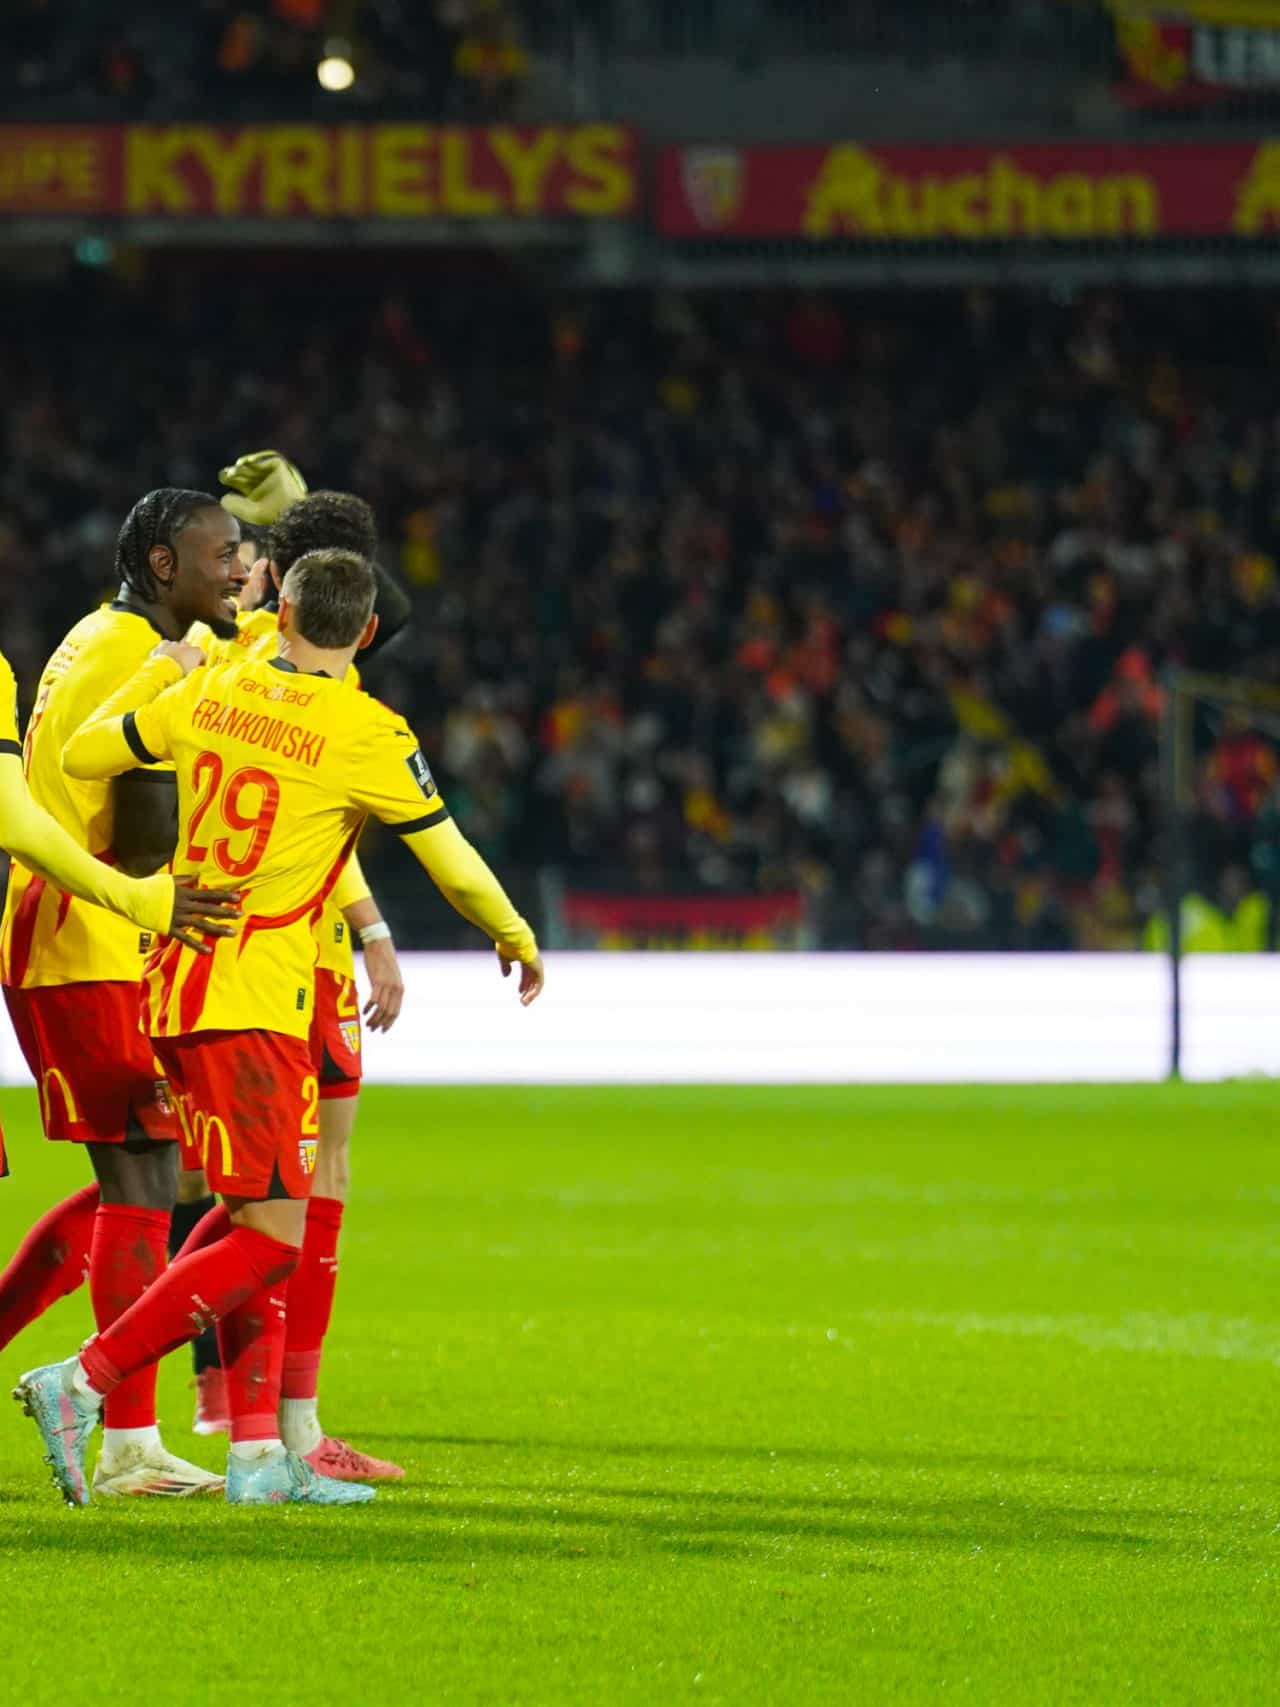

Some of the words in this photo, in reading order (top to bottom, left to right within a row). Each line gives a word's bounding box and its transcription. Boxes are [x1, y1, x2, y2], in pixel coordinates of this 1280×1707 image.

[124, 124, 635, 217] KYRIELYS
[803, 144, 1156, 238] Auchan
[192, 698, 327, 768] FRANKOWSKI
[185, 750, 280, 877] 29
